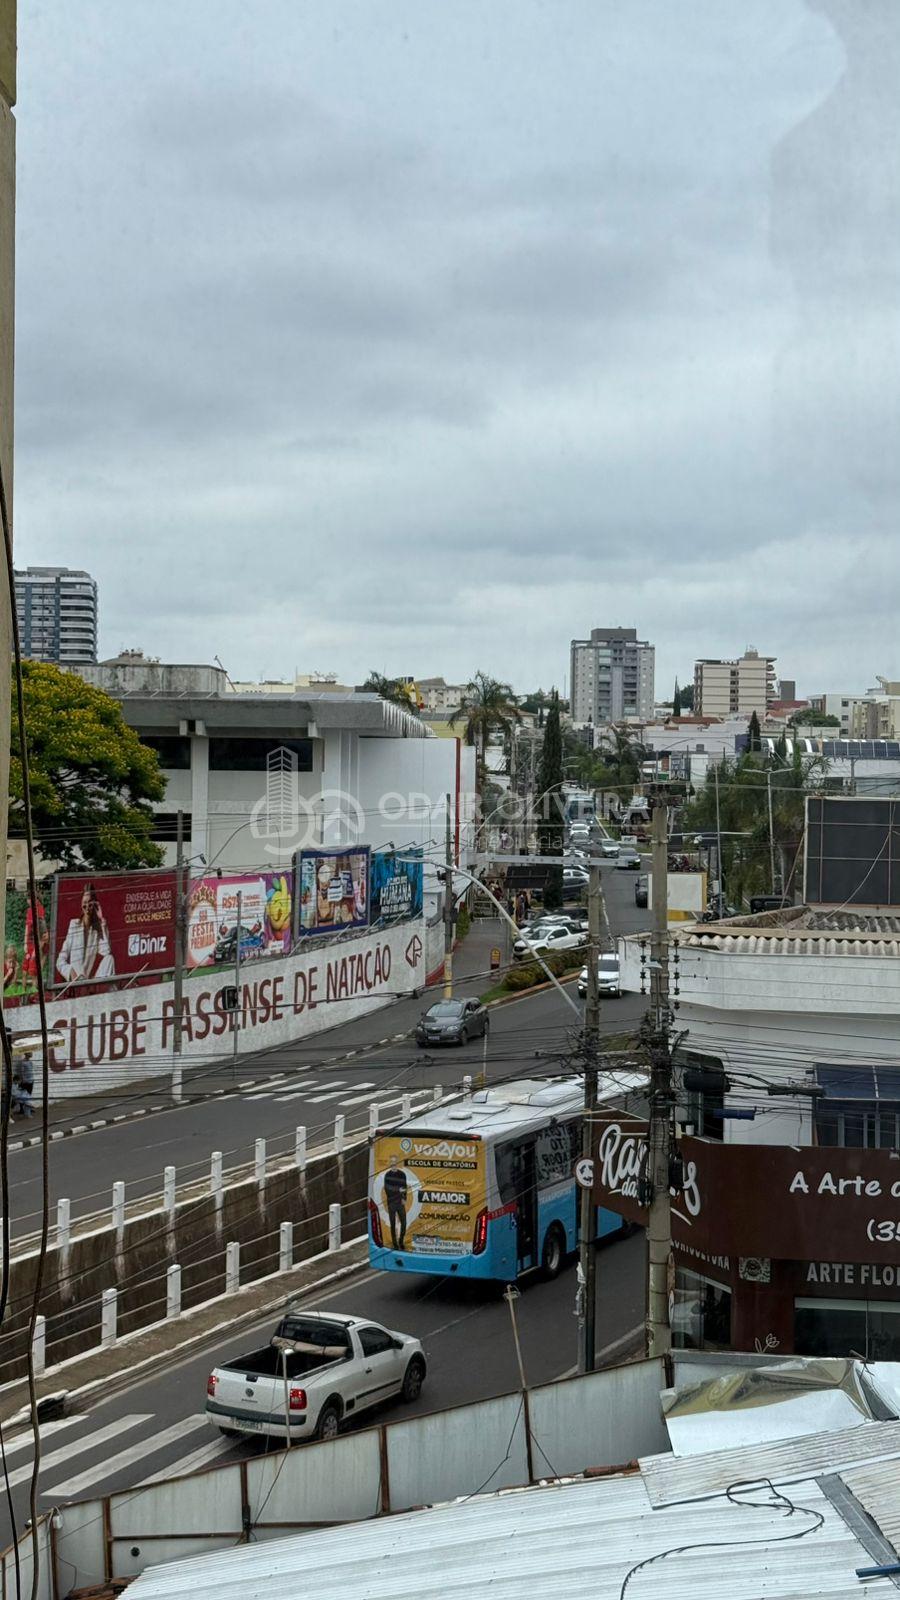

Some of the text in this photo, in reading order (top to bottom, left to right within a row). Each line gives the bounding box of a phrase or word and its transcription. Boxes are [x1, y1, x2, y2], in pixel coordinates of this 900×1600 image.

[48, 1004, 147, 1073] CLUBE
[293, 966, 318, 1015] DE
[326, 942, 391, 1004] NATAÇÃO
[443, 1161, 476, 1169] ORATÓRIA
[789, 1171, 809, 1193] A
[817, 1172, 882, 1196] Arte
[422, 1191, 467, 1204] A MAIOR
[807, 1262, 900, 1286] ARTE FLO
